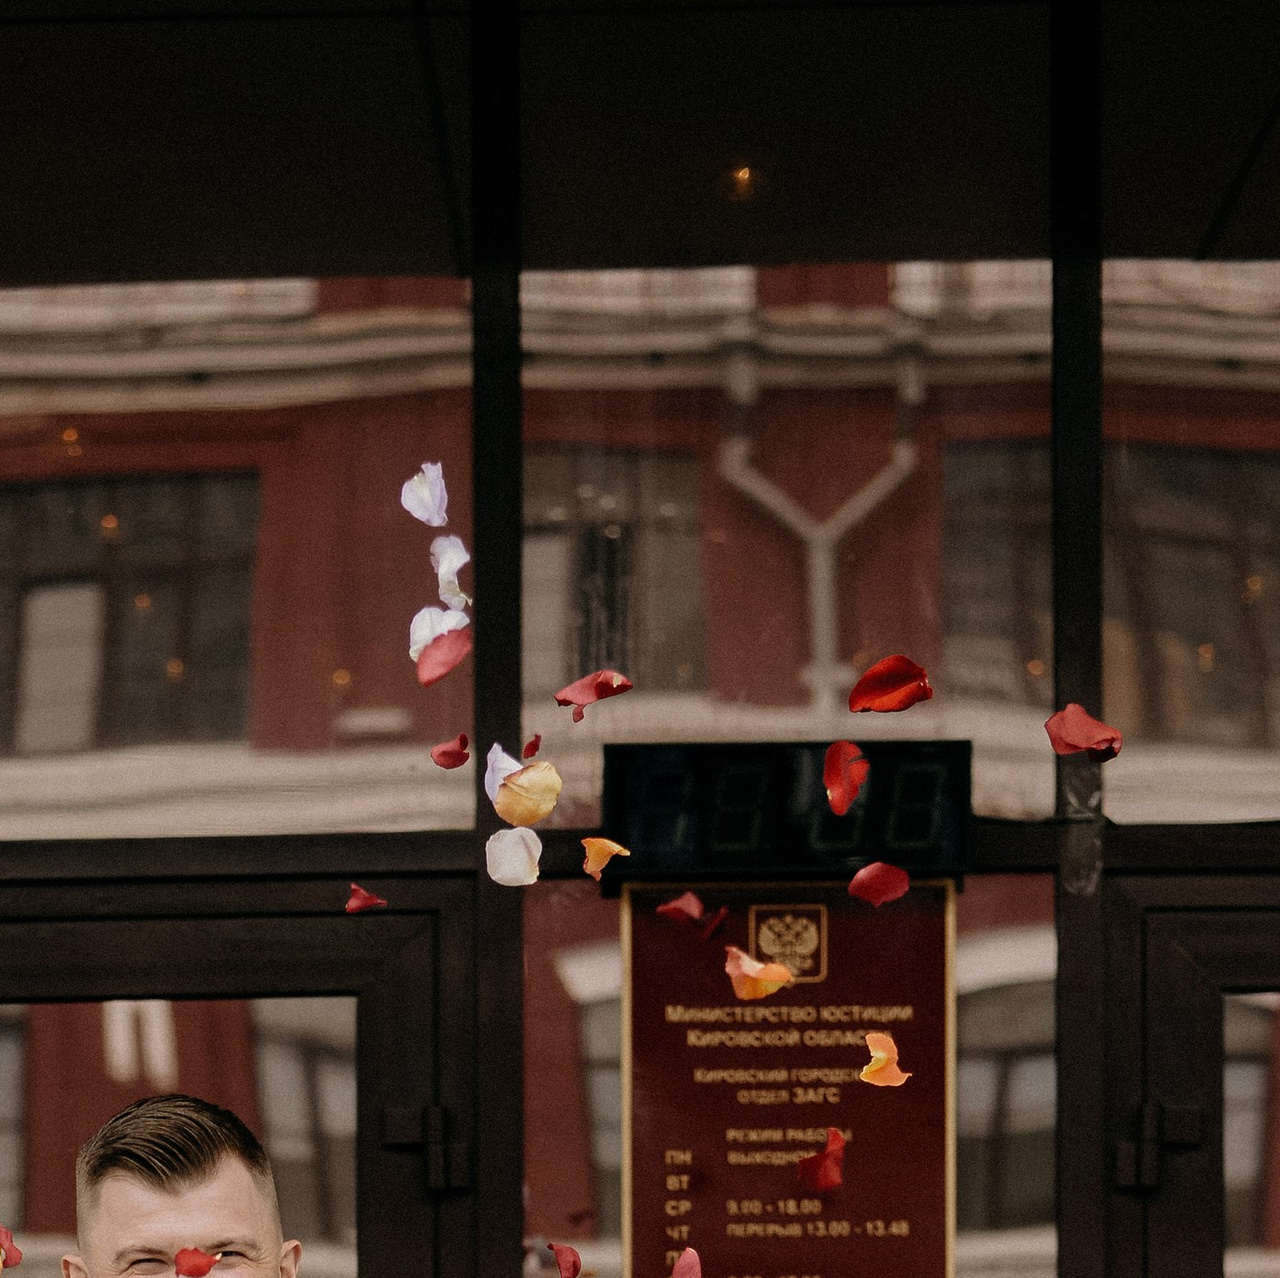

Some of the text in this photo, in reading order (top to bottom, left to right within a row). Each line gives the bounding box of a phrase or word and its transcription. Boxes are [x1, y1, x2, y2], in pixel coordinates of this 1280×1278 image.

[803, 1030, 892, 1047] ОБЛАС
[793, 1087, 841, 1104] ЗАГС
[665, 1150, 693, 1166] ПН
[666, 1174, 690, 1191] ВТ
[664, 1199, 692, 1216] СР
[666, 1224, 690, 1241] ЧТ
[726, 1222, 803, 1237] ПЕРЕРЫВ
